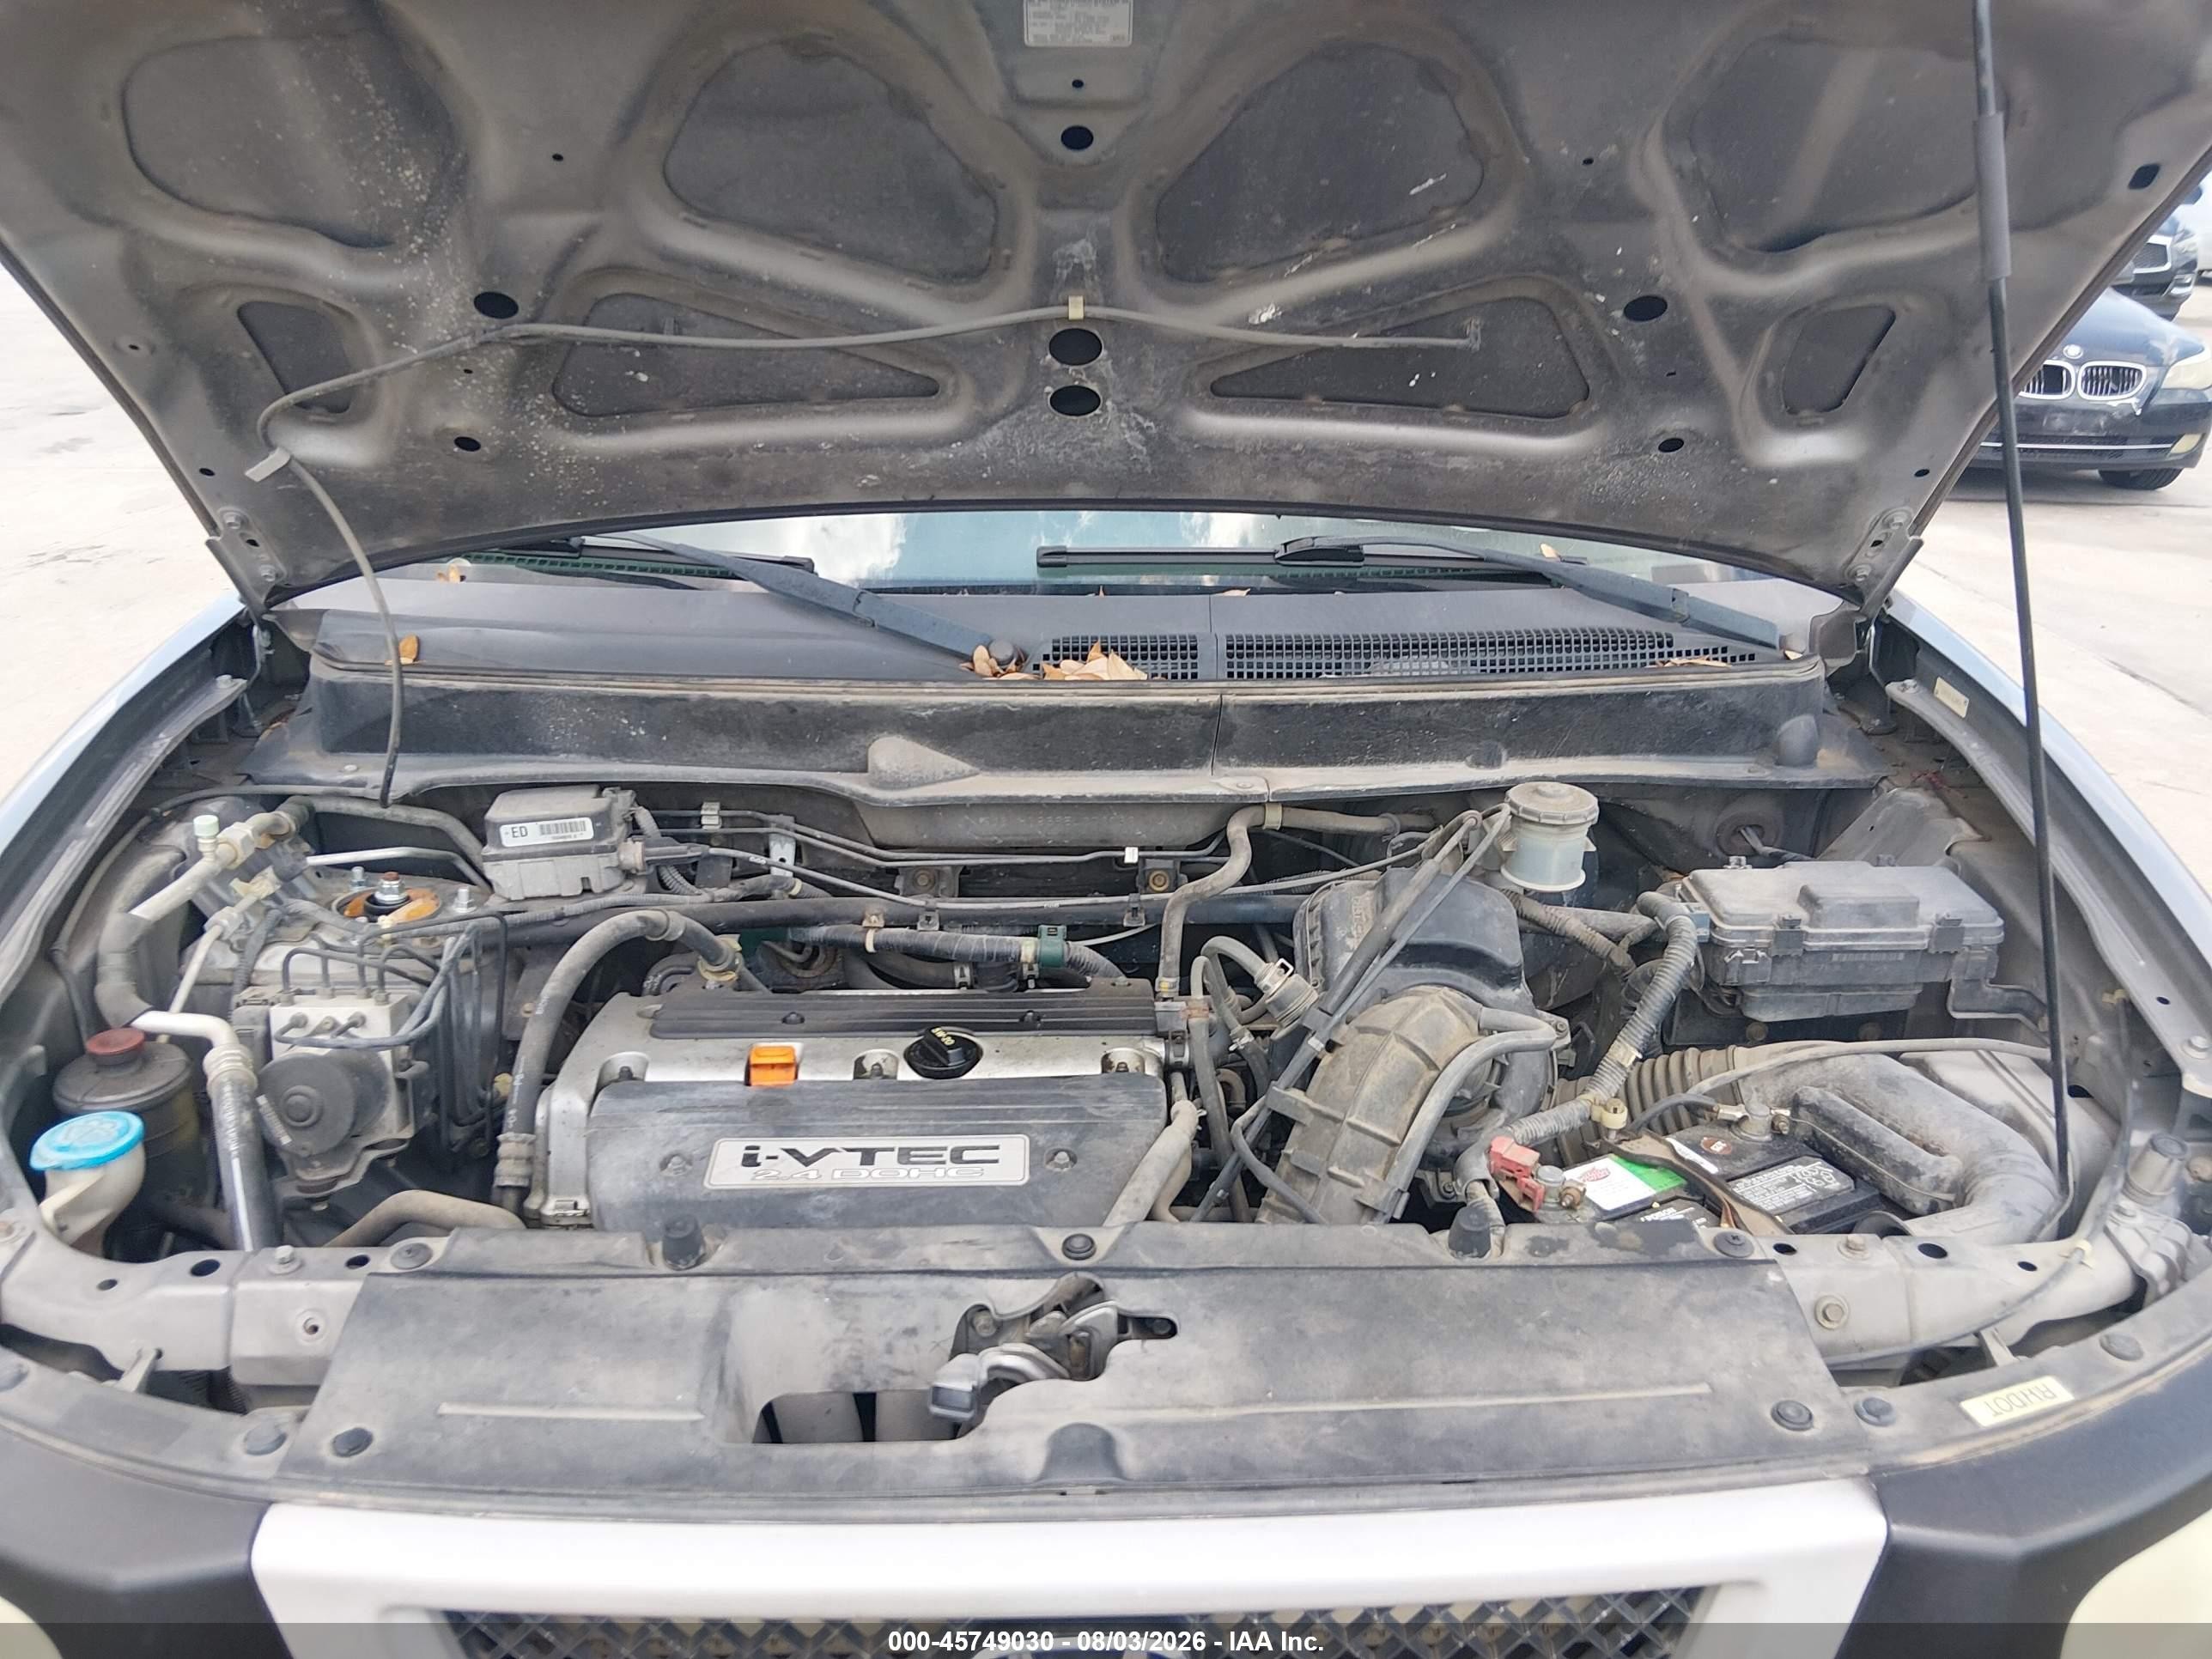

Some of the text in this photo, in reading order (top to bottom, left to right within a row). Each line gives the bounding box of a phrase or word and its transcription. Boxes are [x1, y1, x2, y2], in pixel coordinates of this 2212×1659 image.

[511, 825, 529, 839] ED
[741, 1145, 1000, 1168] i-VTEC
[752, 1166, 985, 1181] 2.4 DOHC
